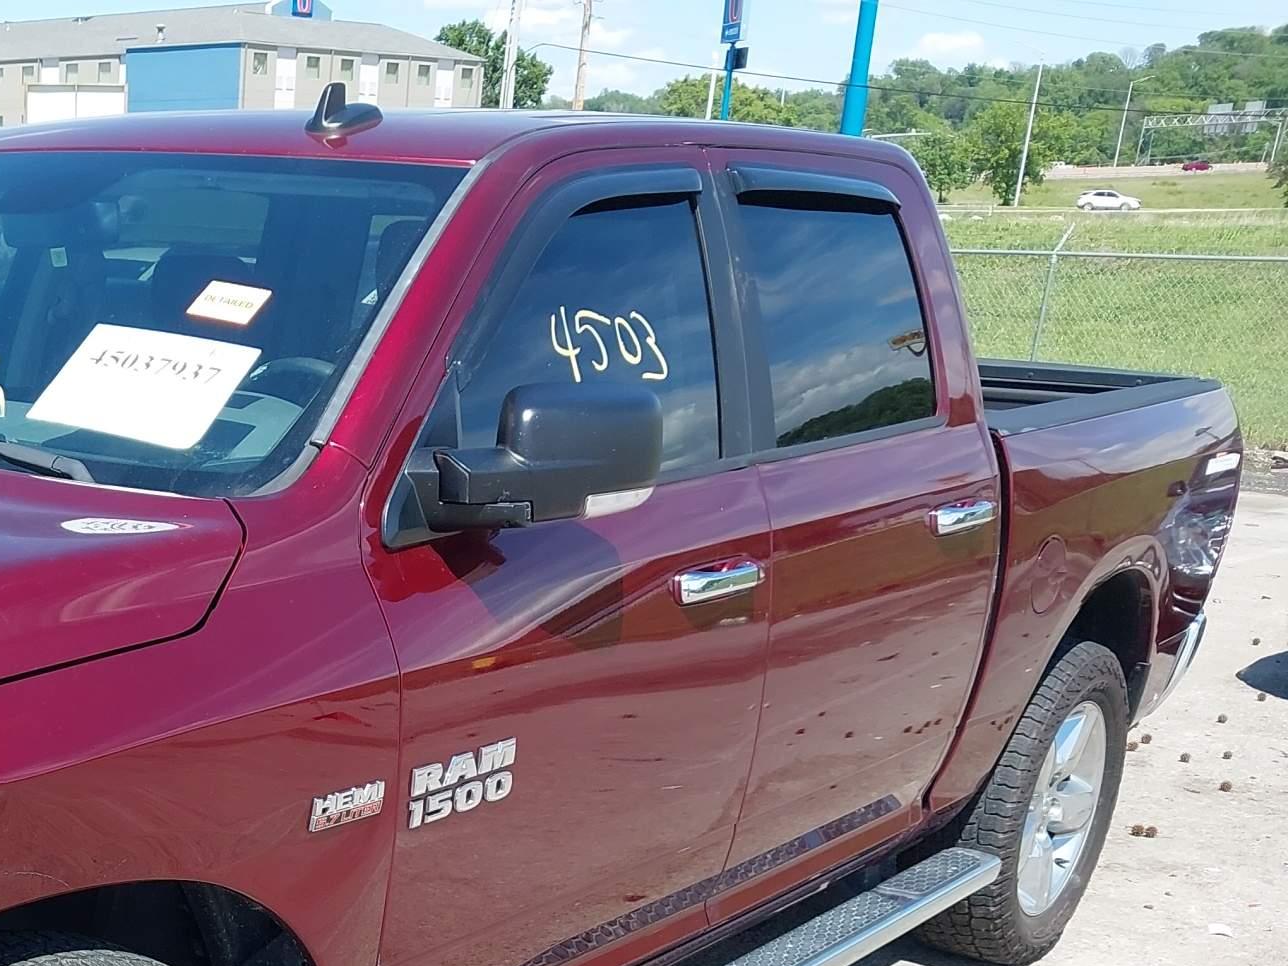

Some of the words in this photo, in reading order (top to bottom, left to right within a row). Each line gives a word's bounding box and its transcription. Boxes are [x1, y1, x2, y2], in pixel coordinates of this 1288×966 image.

[89, 349, 223, 385] 45037937
[550, 305, 669, 383] 4503
[411, 738, 517, 796] RAM
[312, 780, 386, 817] HEMI
[315, 813, 341, 829] 5.7
[341, 801, 381, 822] LITER
[408, 771, 513, 829] 1500
